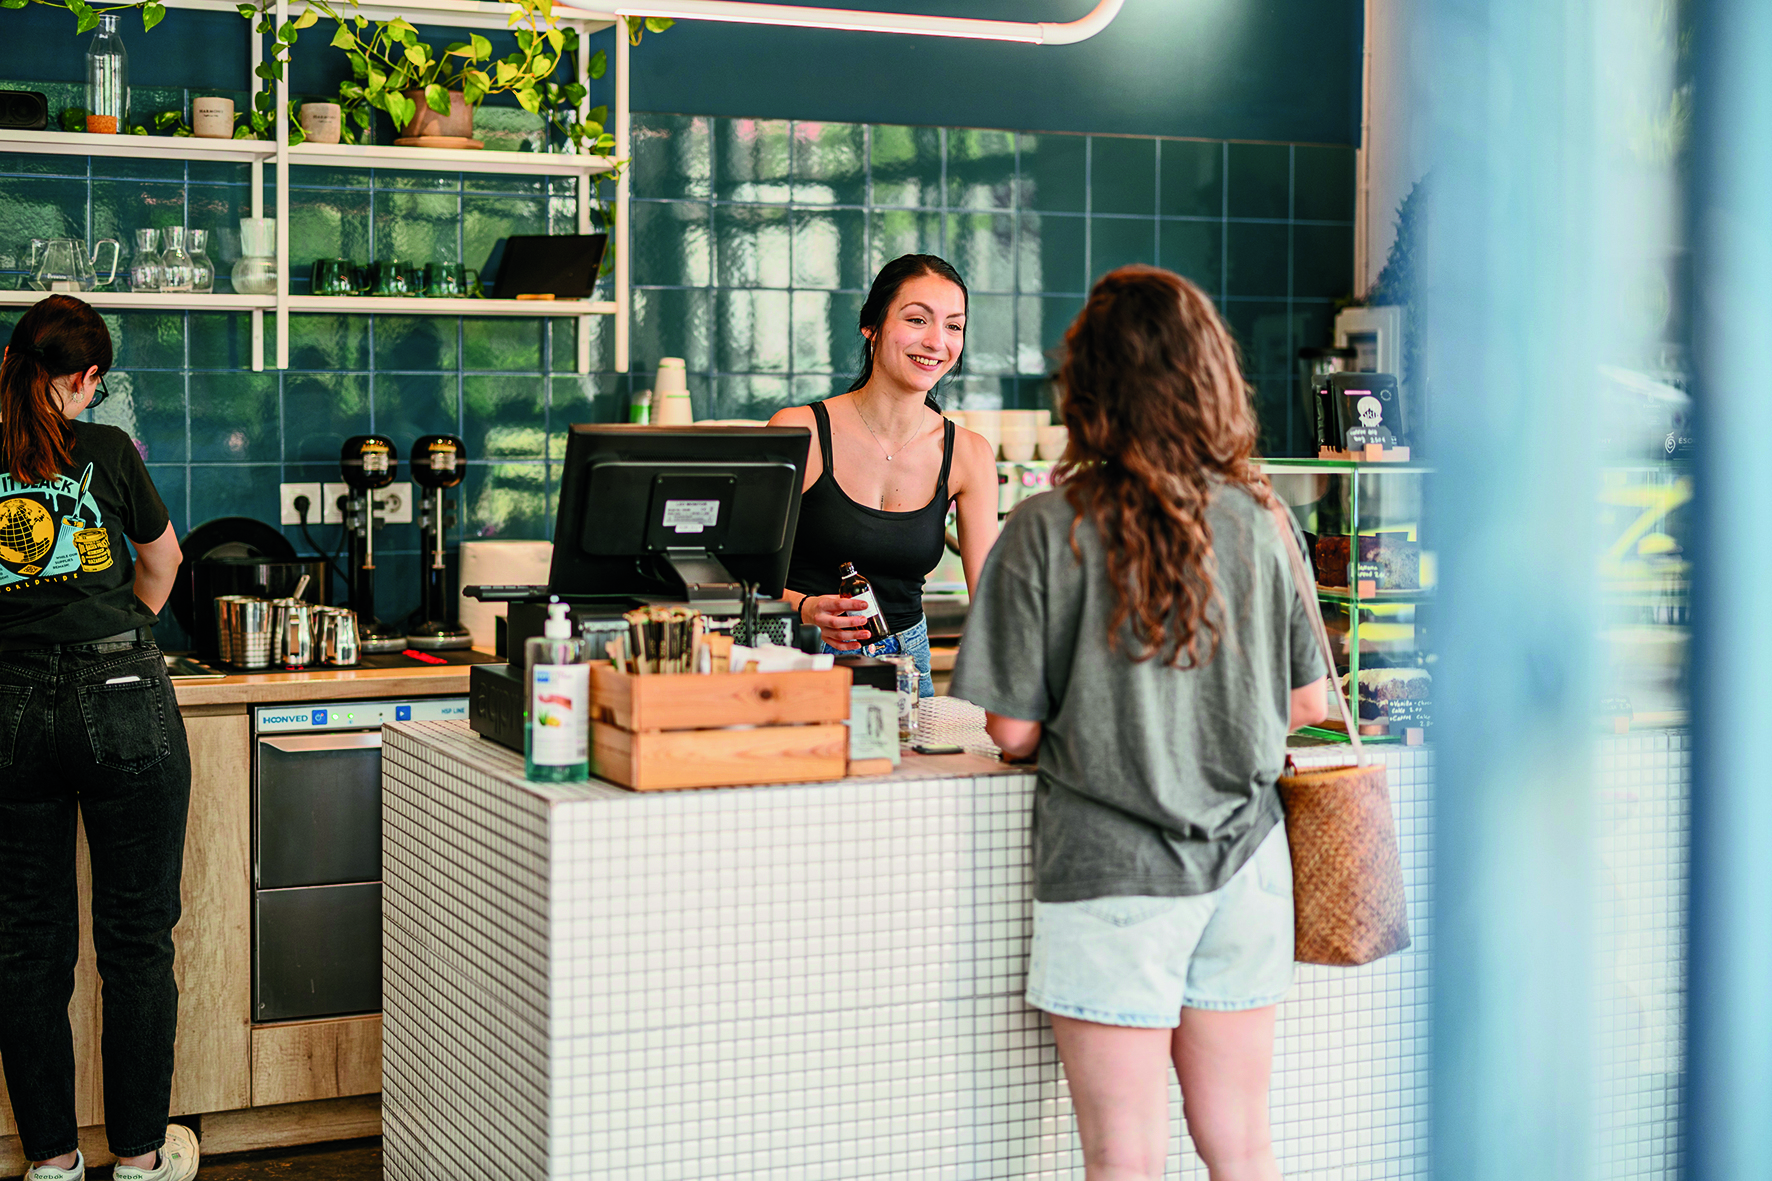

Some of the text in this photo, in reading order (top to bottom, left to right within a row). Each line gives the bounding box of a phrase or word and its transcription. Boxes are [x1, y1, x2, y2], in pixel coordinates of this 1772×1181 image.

[2, 476, 16, 492] IT
[0, 573, 78, 593] ORLDWIDE
[263, 714, 308, 724] HOONVED
[116, 1172, 143, 1180] Reebok
